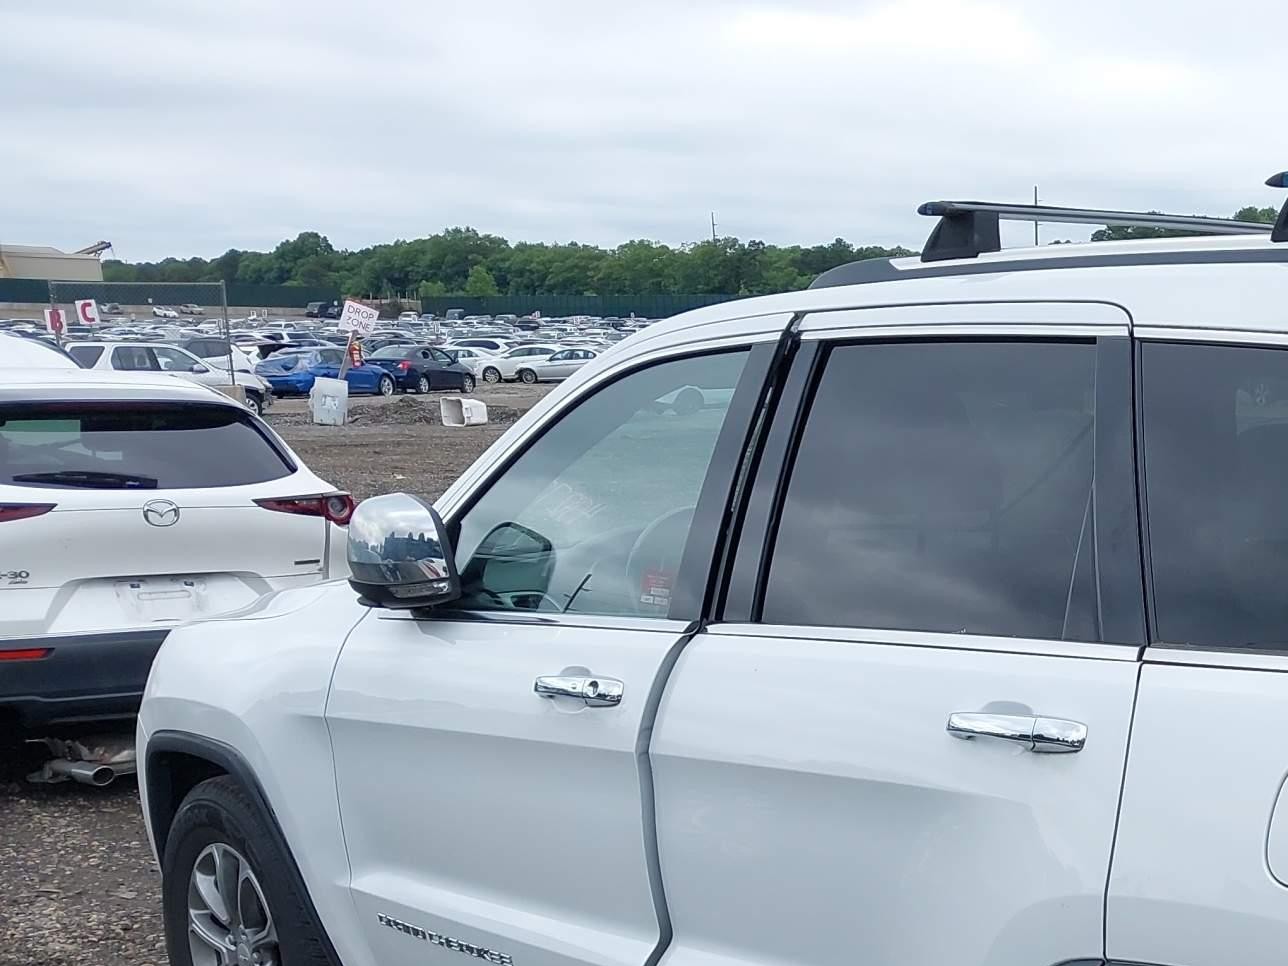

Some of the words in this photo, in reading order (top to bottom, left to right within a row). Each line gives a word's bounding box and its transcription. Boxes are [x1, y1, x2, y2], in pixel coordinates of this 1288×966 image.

[81, 302, 96, 323] C
[347, 304, 375, 321] DROP
[346, 316, 371, 333] ZONE
